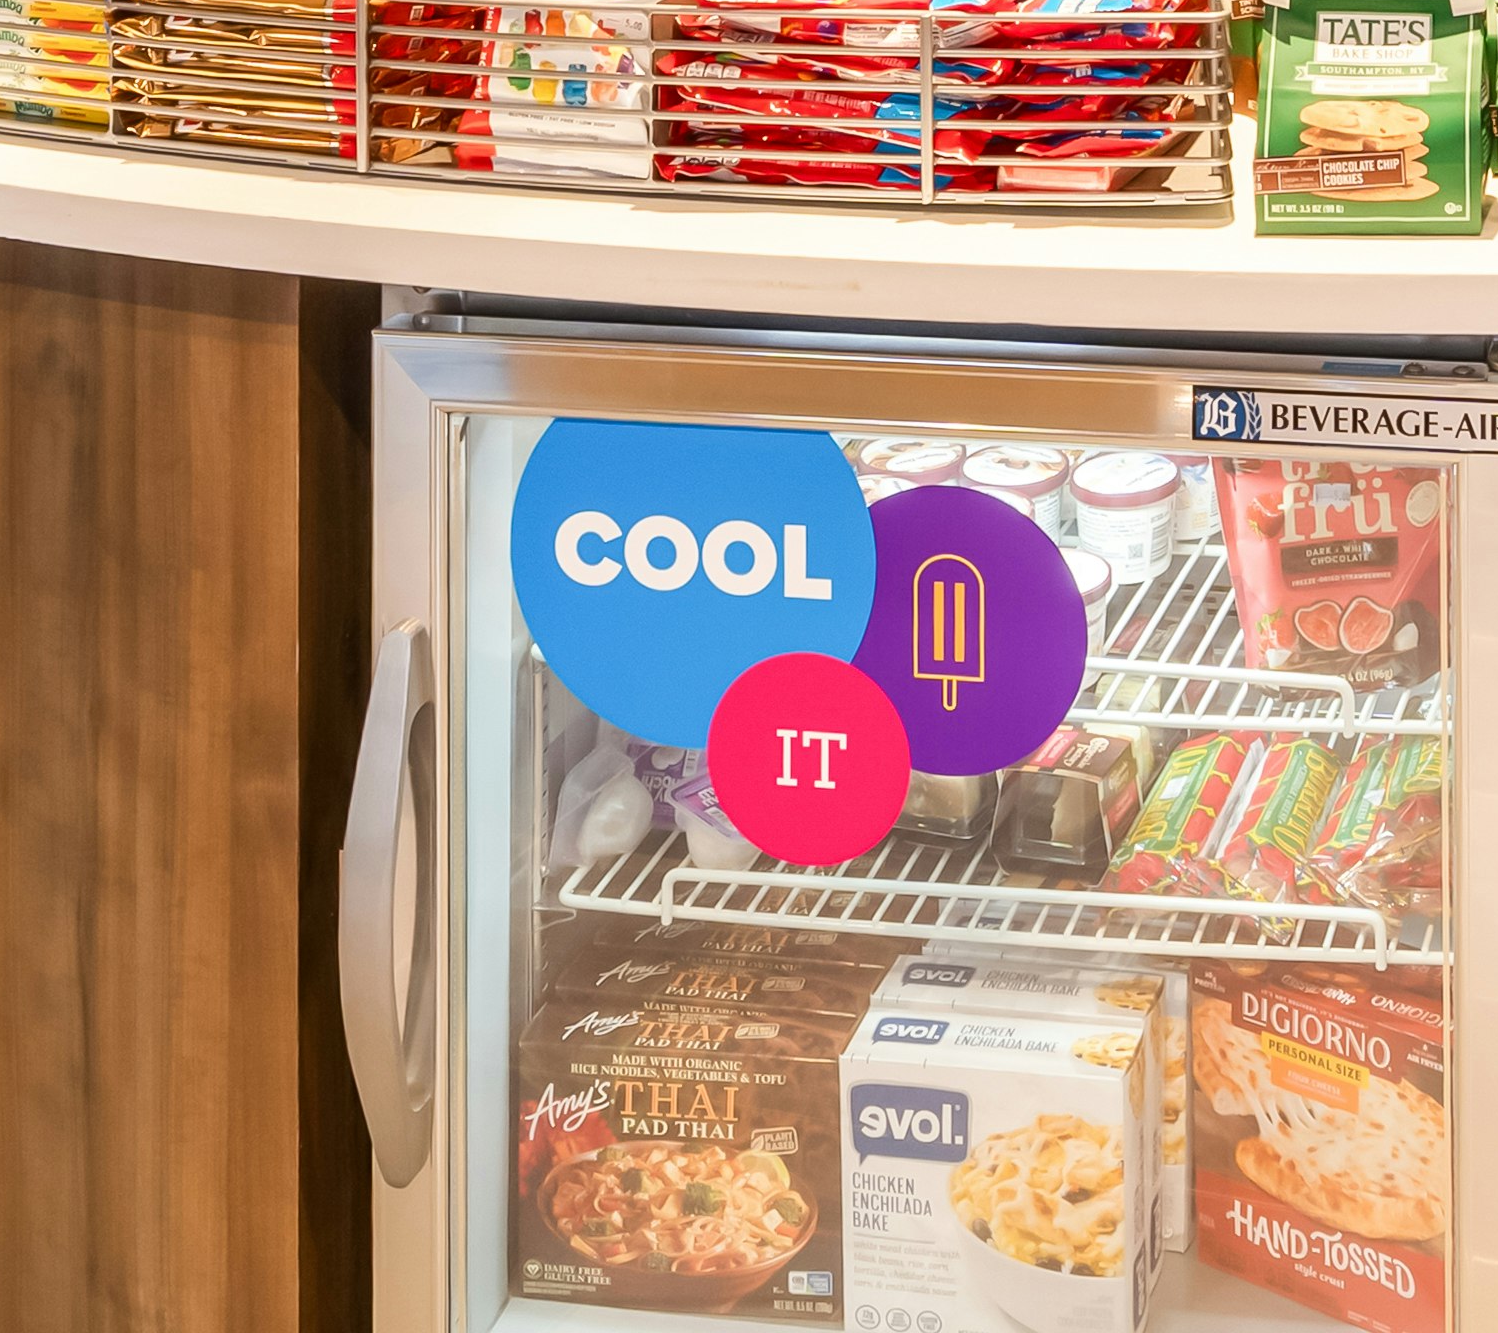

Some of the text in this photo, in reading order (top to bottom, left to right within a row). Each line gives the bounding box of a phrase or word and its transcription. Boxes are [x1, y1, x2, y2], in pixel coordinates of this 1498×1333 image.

[624, 16, 643, 31] 5.00
[1322, 17, 1427, 47] TATE'S
[1331, 47, 1414, 60] BAKE SHOP
[1409, 66, 1425, 75] NY
[1322, 160, 1375, 174] CHOCOLATE
[1376, 157, 1400, 171] CHIP
[1323, 172, 1365, 186] COOKIES
[1271, 203, 1285, 213] NET
[554, 510, 833, 601] COOL
[1305, 546, 1332, 558] DARK
[1309, 551, 1370, 566] CHOCOLATE
[775, 727, 848, 790] IT
[985, 969, 1040, 983] CHICKEN
[664, 986, 700, 997] PAD
[980, 979, 1084, 998] ENCHILADA BAKE
[561, 1010, 645, 1041] Amy's
[638, 1021, 734, 1043] THAI
[879, 1020, 941, 1040] evol.
[960, 1023, 1017, 1038] CHICKEN
[633, 1037, 722, 1051] PAD THAI
[953, 1035, 1058, 1054] ENCHILADA BAKE
[611, 1054, 743, 1071] MADE WITH ORGANIC
[1267, 1038, 1363, 1082] PERSONAL SIZE
[1406, 1053, 1419, 1065] AIR
[570, 1063, 787, 1085] RICE NOODLES, VEGETABLES & TOFU
[524, 1078, 614, 1141] Amy's
[613, 1079, 740, 1122] THAI
[621, 1117, 736, 1141] PAD THAI
[858, 1101, 965, 1146] evol.
[763, 1131, 793, 1144] PLANT
[764, 1140, 796, 1151] BASED
[851, 1171, 916, 1196] CHICKEN
[851, 1191, 934, 1218] ENCHILADA
[851, 1211, 890, 1233] BAKE
[1224, 1197, 1417, 1299] HAND-TOSSED
[543, 1263, 603, 1276] DAIRY FREE
[543, 1272, 612, 1285] GLUTEN FREE
[1293, 1262, 1346, 1290] style crust
